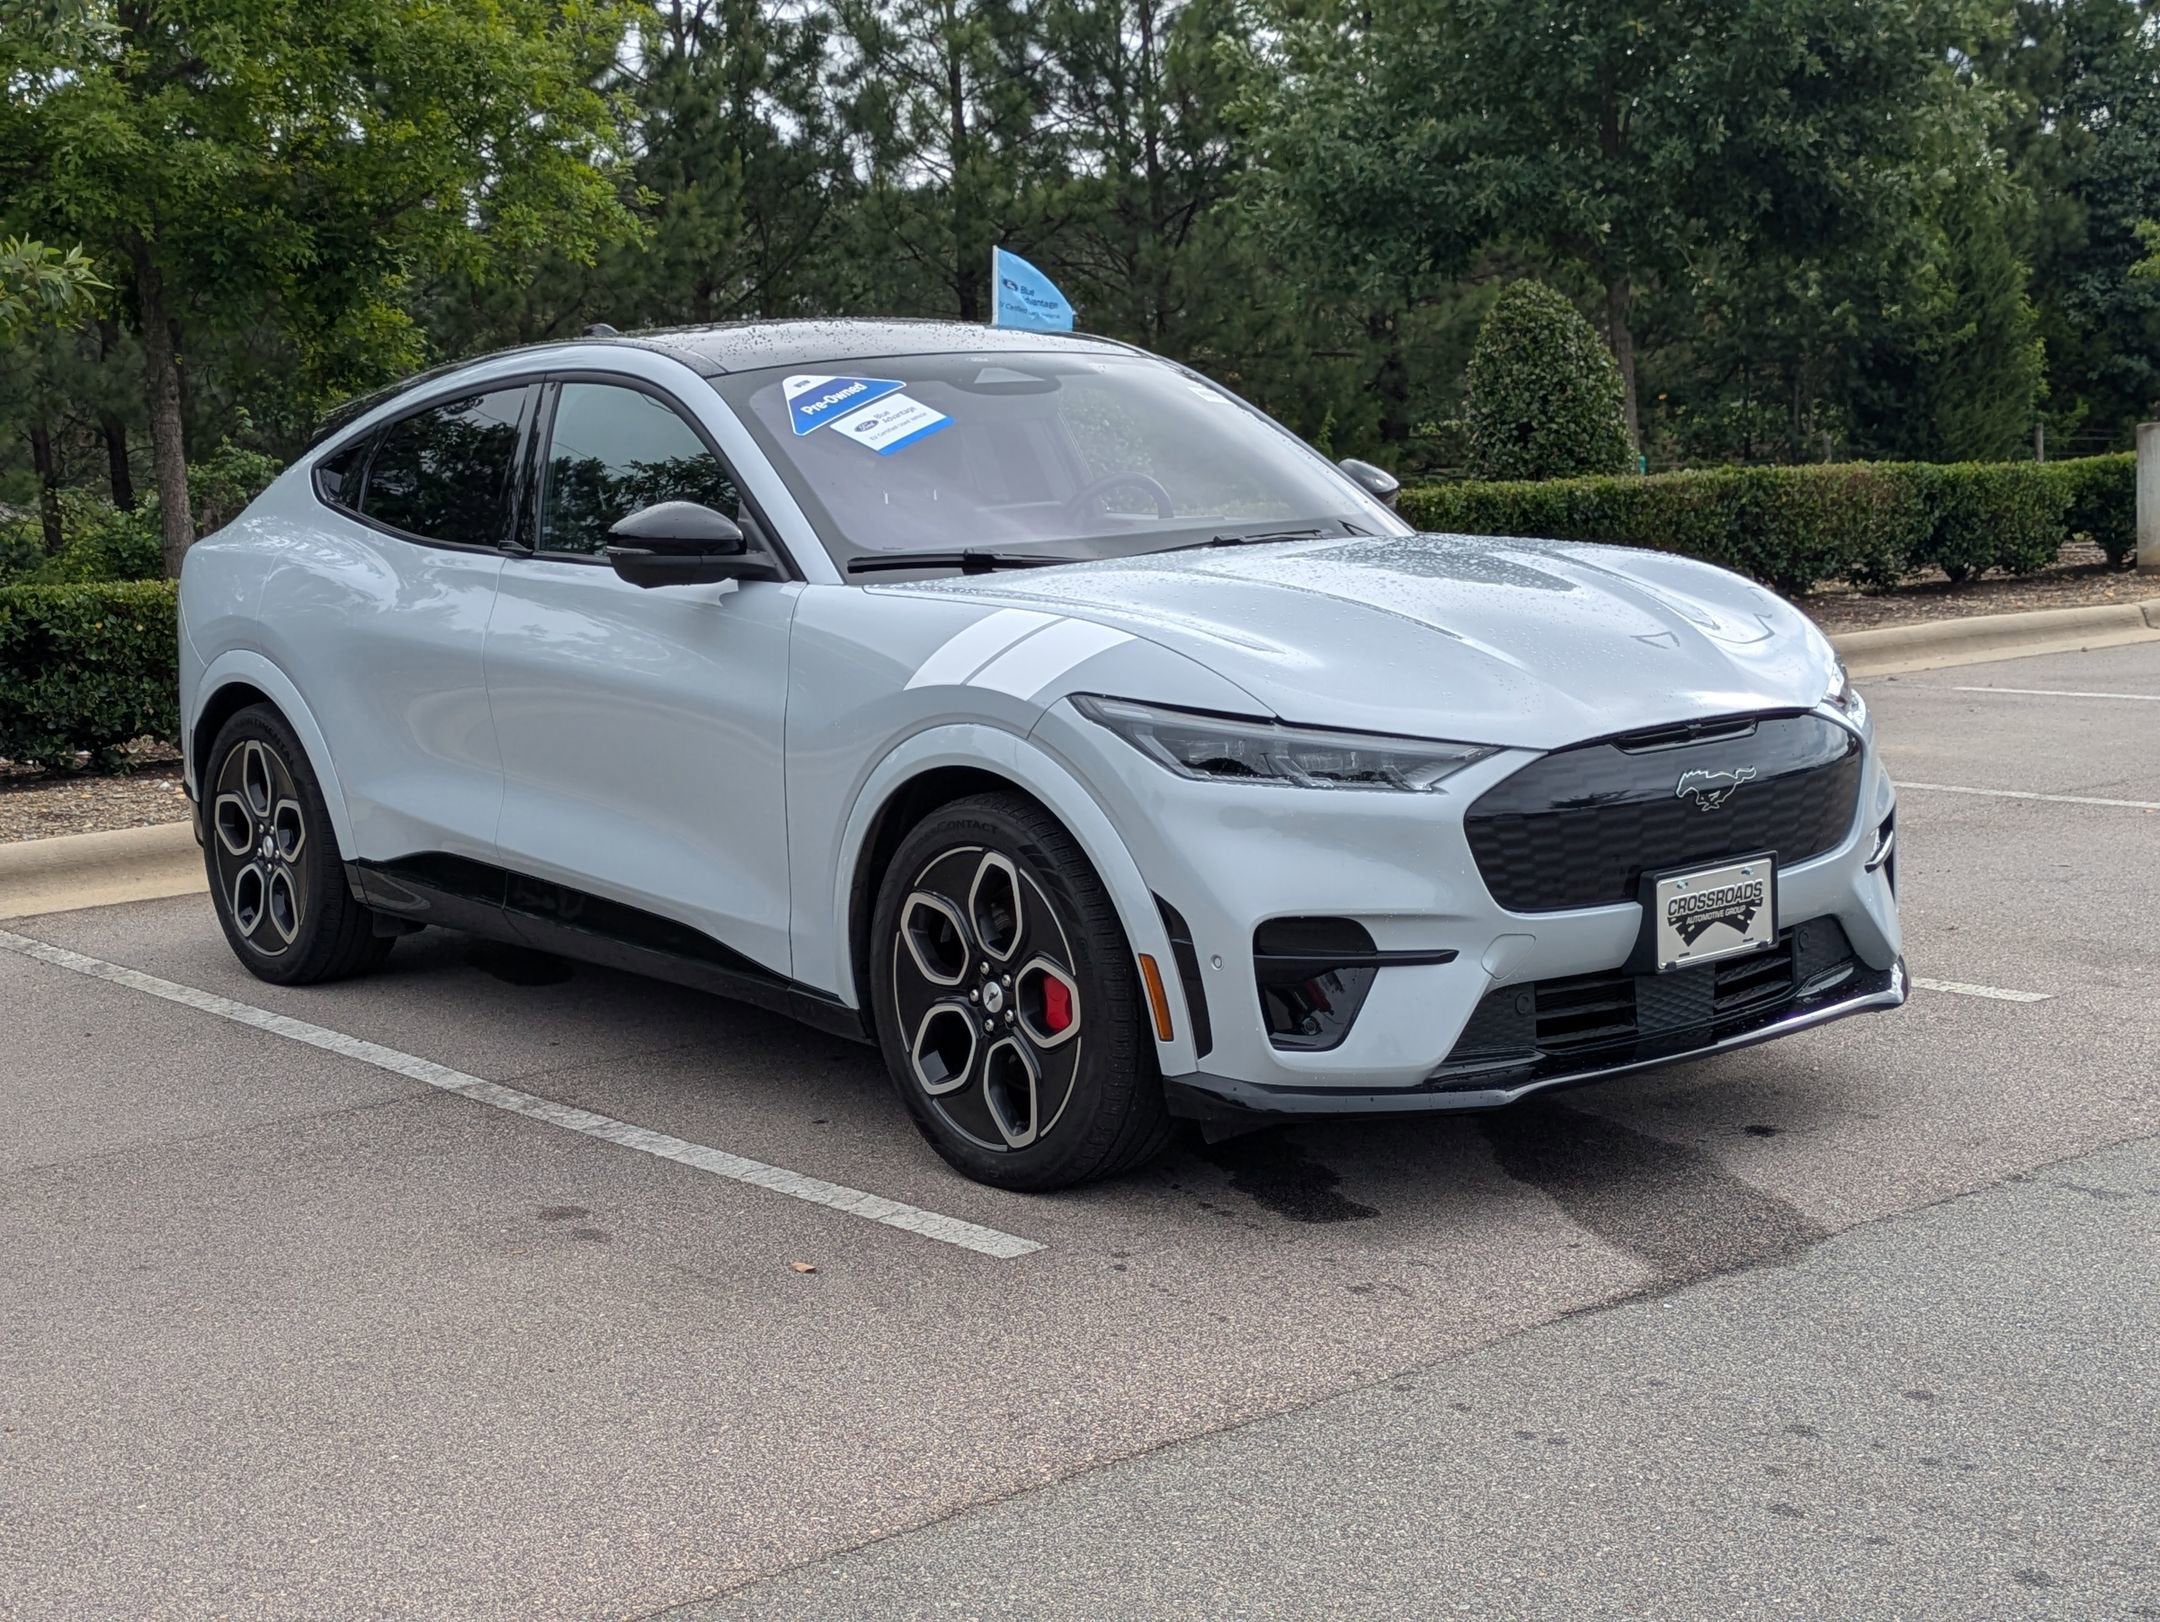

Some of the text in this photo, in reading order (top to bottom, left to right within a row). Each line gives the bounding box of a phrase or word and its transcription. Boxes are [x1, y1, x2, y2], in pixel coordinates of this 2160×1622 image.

[800, 381, 868, 416] Pre-Owned
[1667, 880, 1763, 916] CROSSROADS
[1686, 905, 1746, 924] AUTOMOTIVE GROUP
